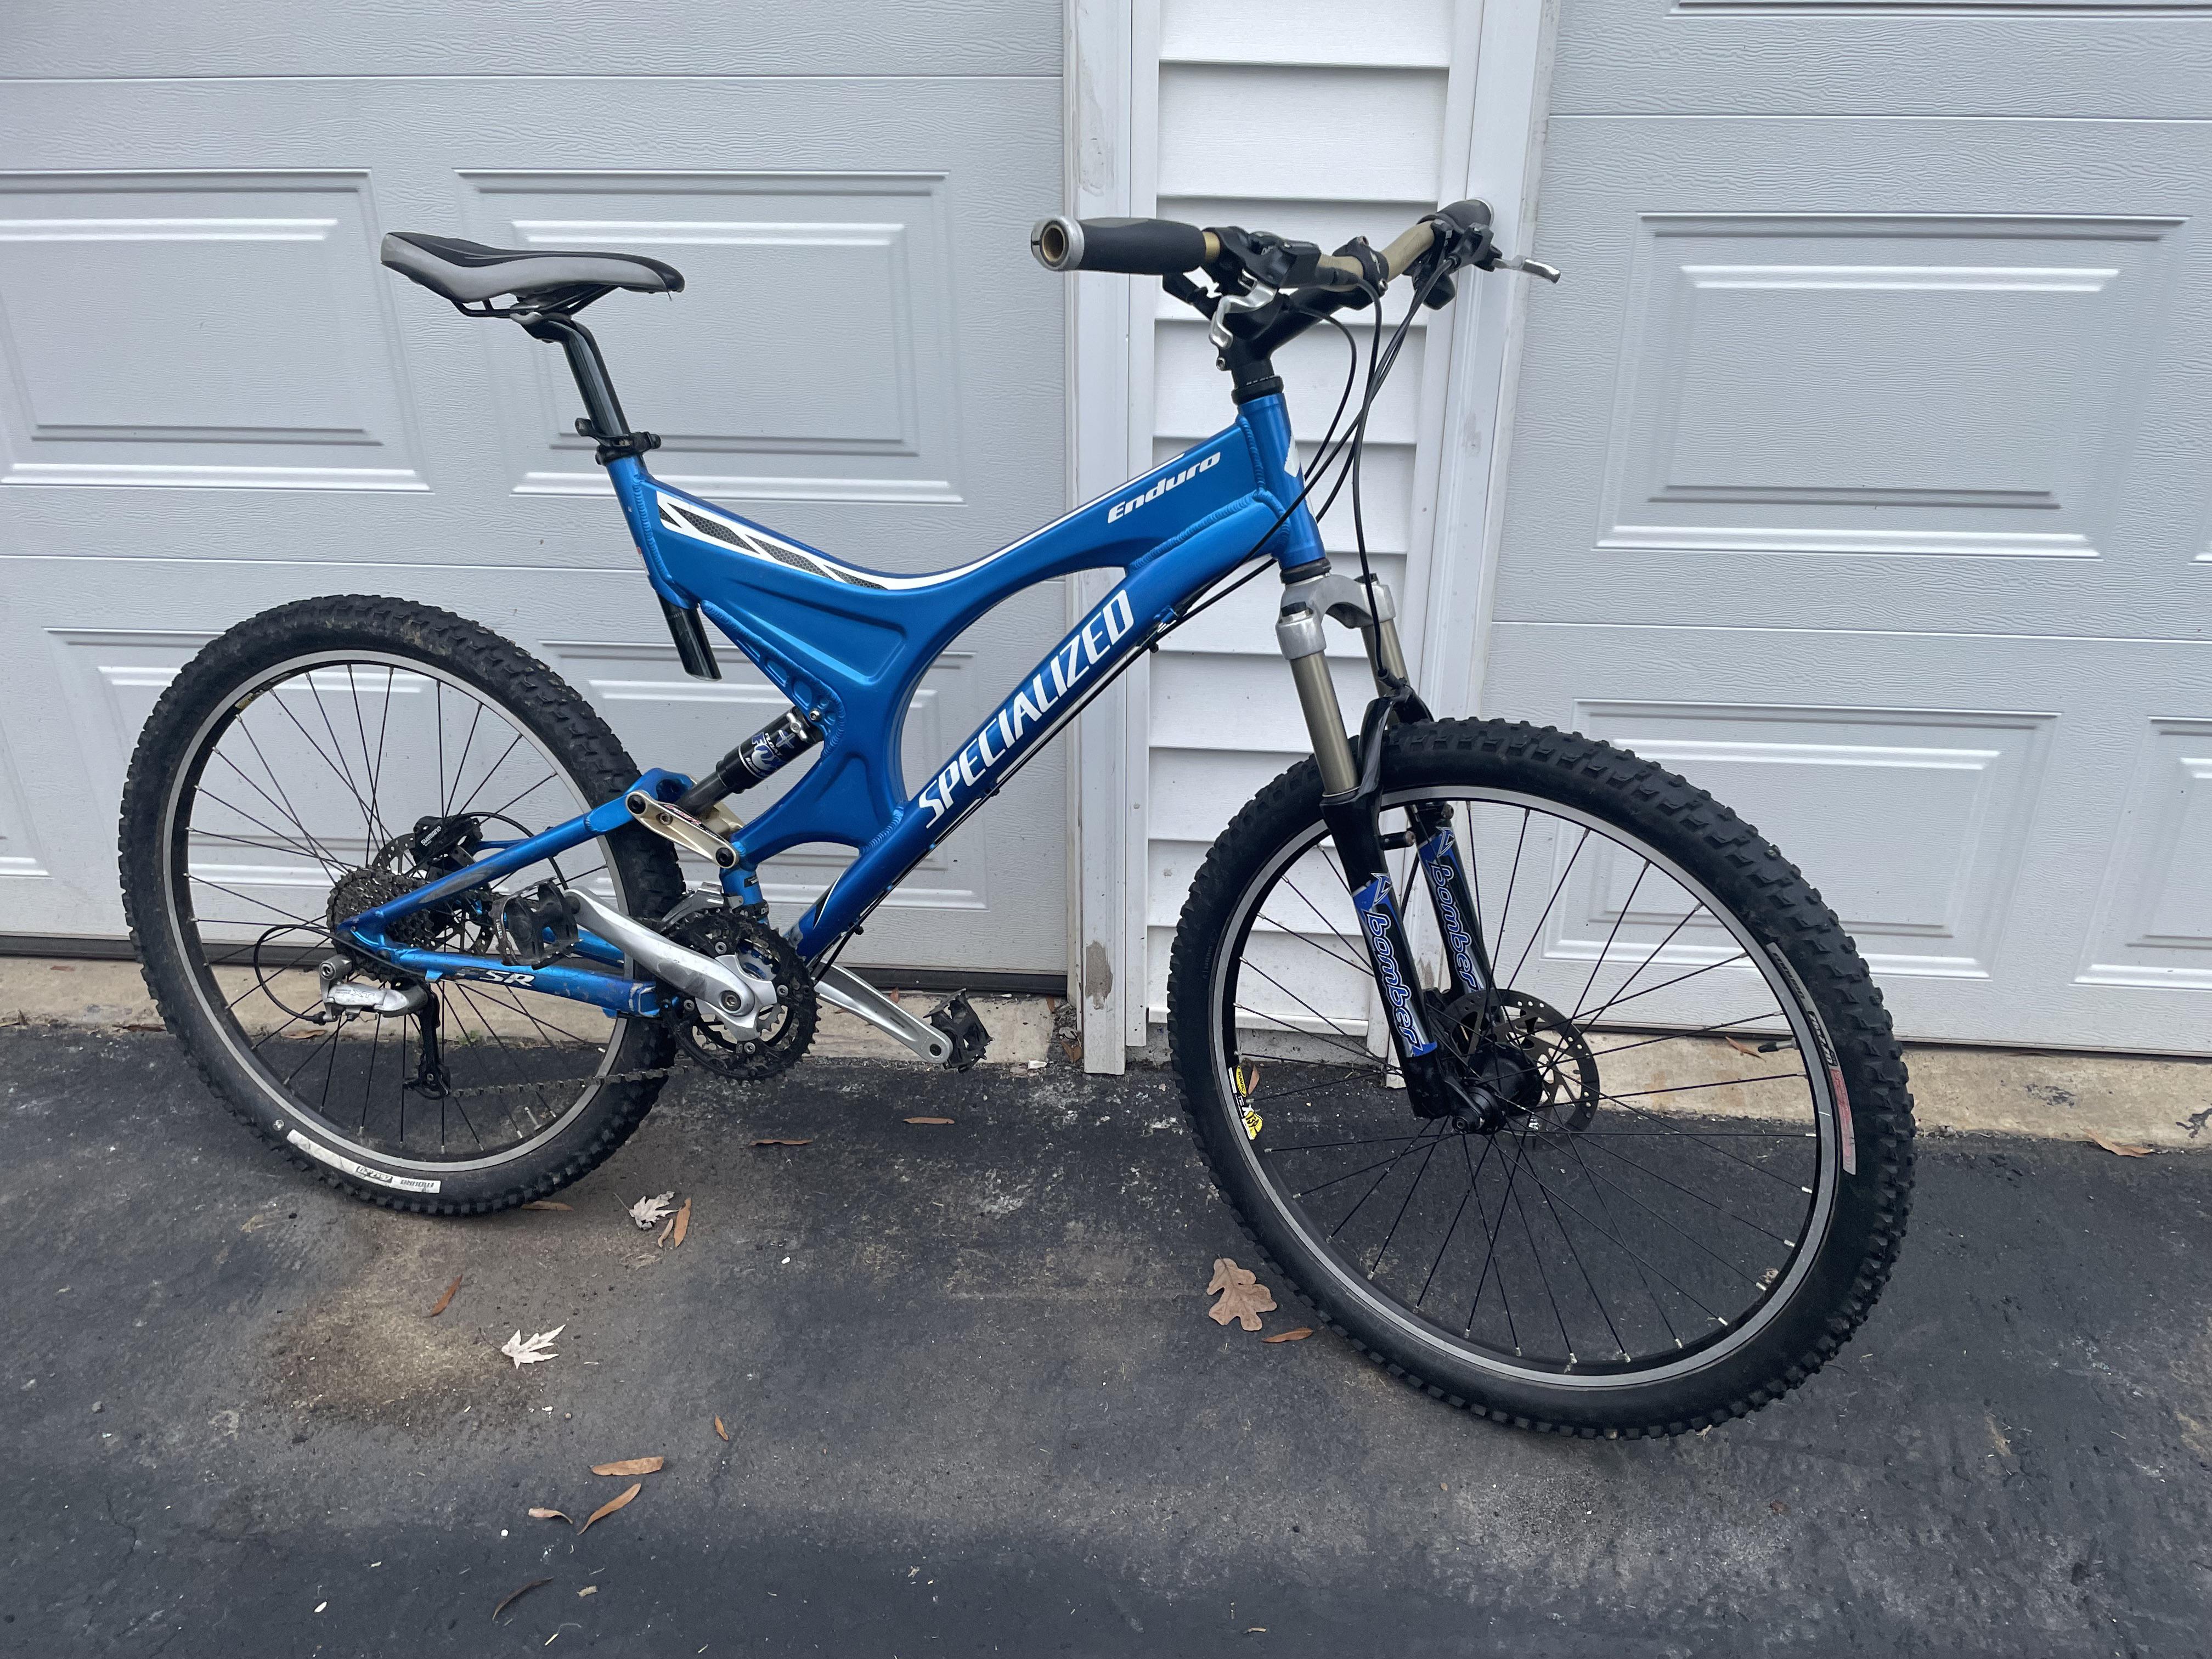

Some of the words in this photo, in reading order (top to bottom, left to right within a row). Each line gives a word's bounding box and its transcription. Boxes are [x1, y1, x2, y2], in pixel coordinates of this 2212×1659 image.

[1107, 452, 1221, 524] Enduro
[918, 589, 1135, 830] SPECIALIZED
[420, 826, 442, 846] SHIMANO
[1430, 861, 1477, 991] bomber
[1365, 910, 1420, 1052] bomber
[1237, 1071, 1245, 1092] MAVIC
